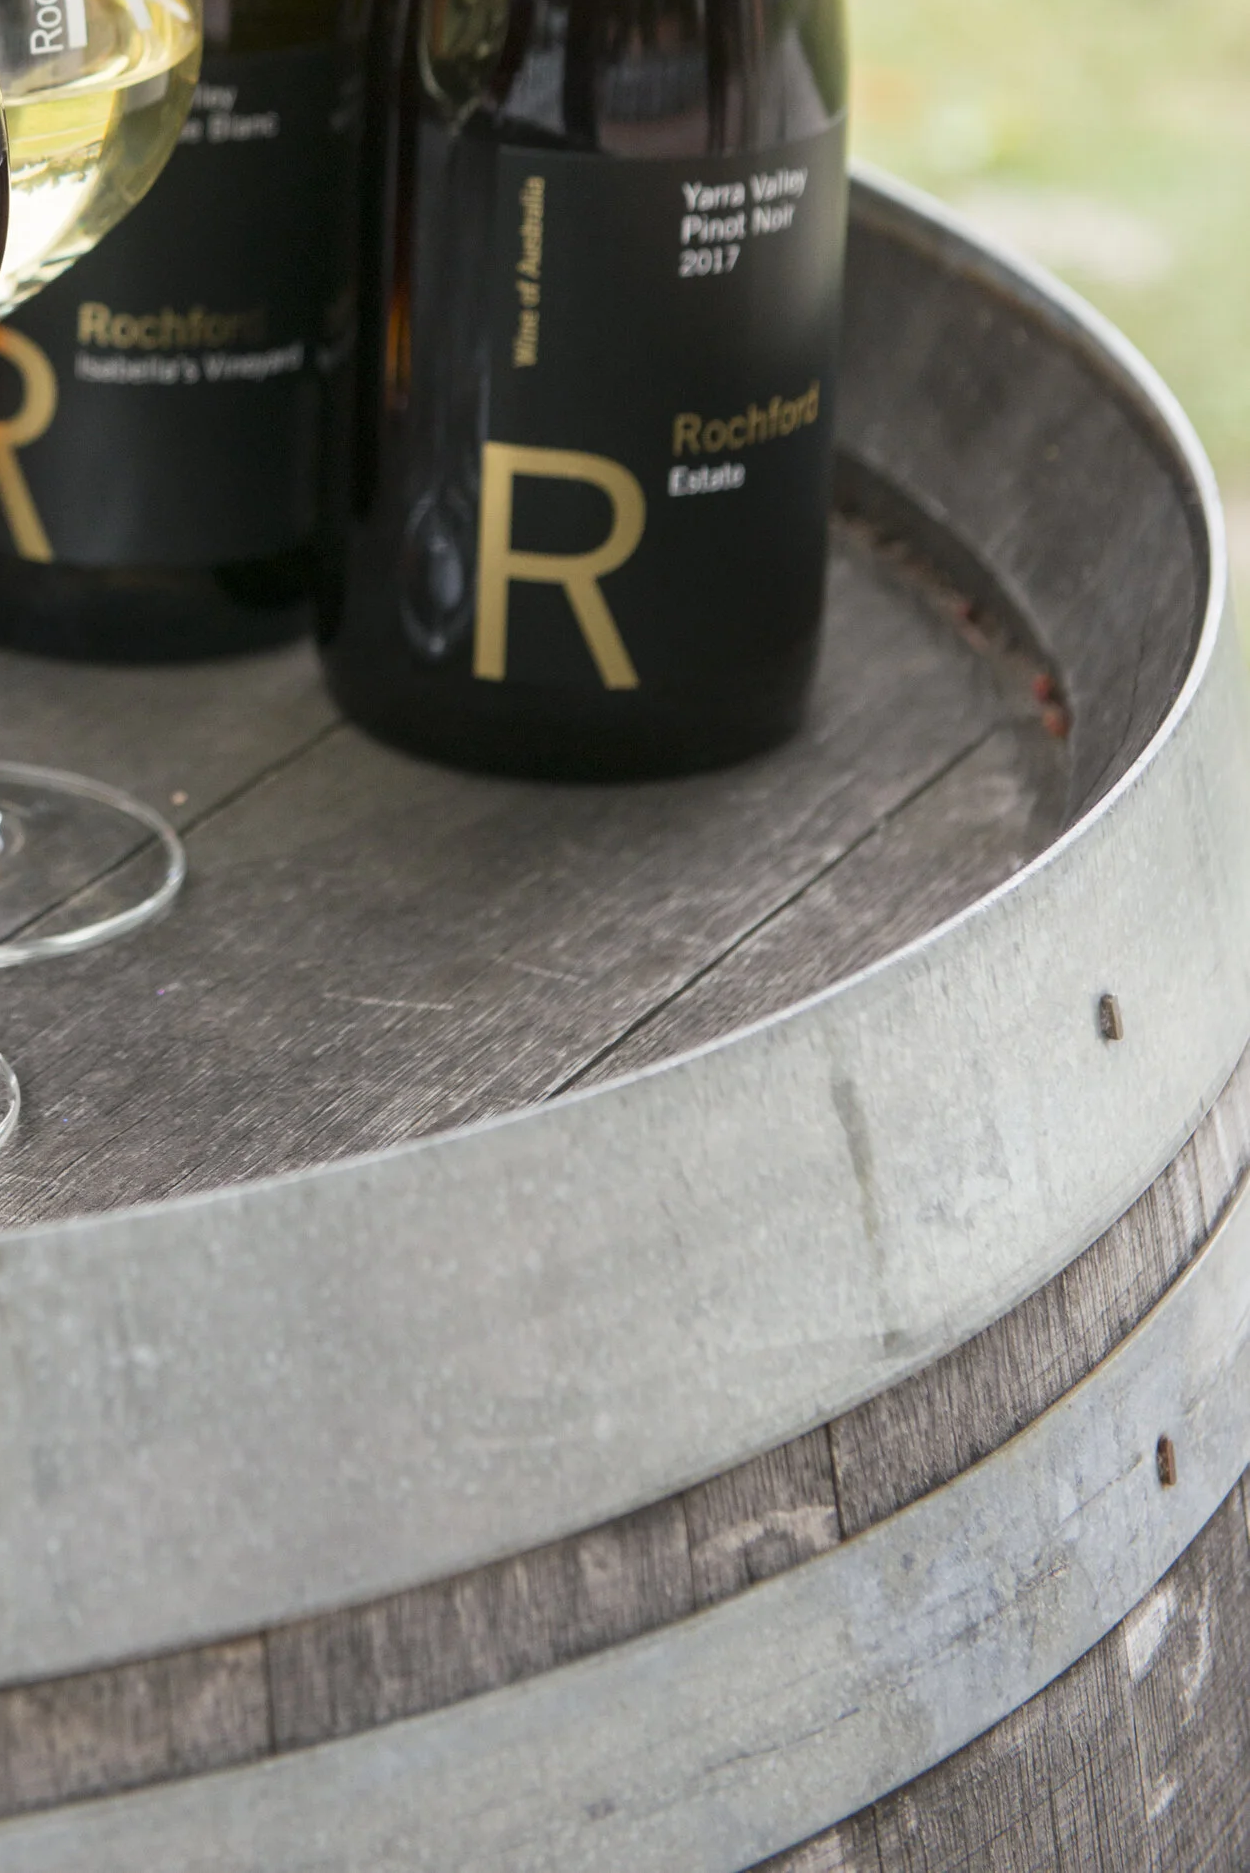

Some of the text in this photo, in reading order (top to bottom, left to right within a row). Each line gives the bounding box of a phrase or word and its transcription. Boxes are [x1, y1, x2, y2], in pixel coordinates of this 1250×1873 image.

[681, 167, 809, 212] Yarra Valley
[516, 176, 546, 279] Australia
[680, 201, 796, 245] Pinot Noir
[679, 243, 741, 278] 2017
[672, 379, 821, 457] Rochford
[668, 461, 746, 497] Estate
[472, 440, 647, 690] R
